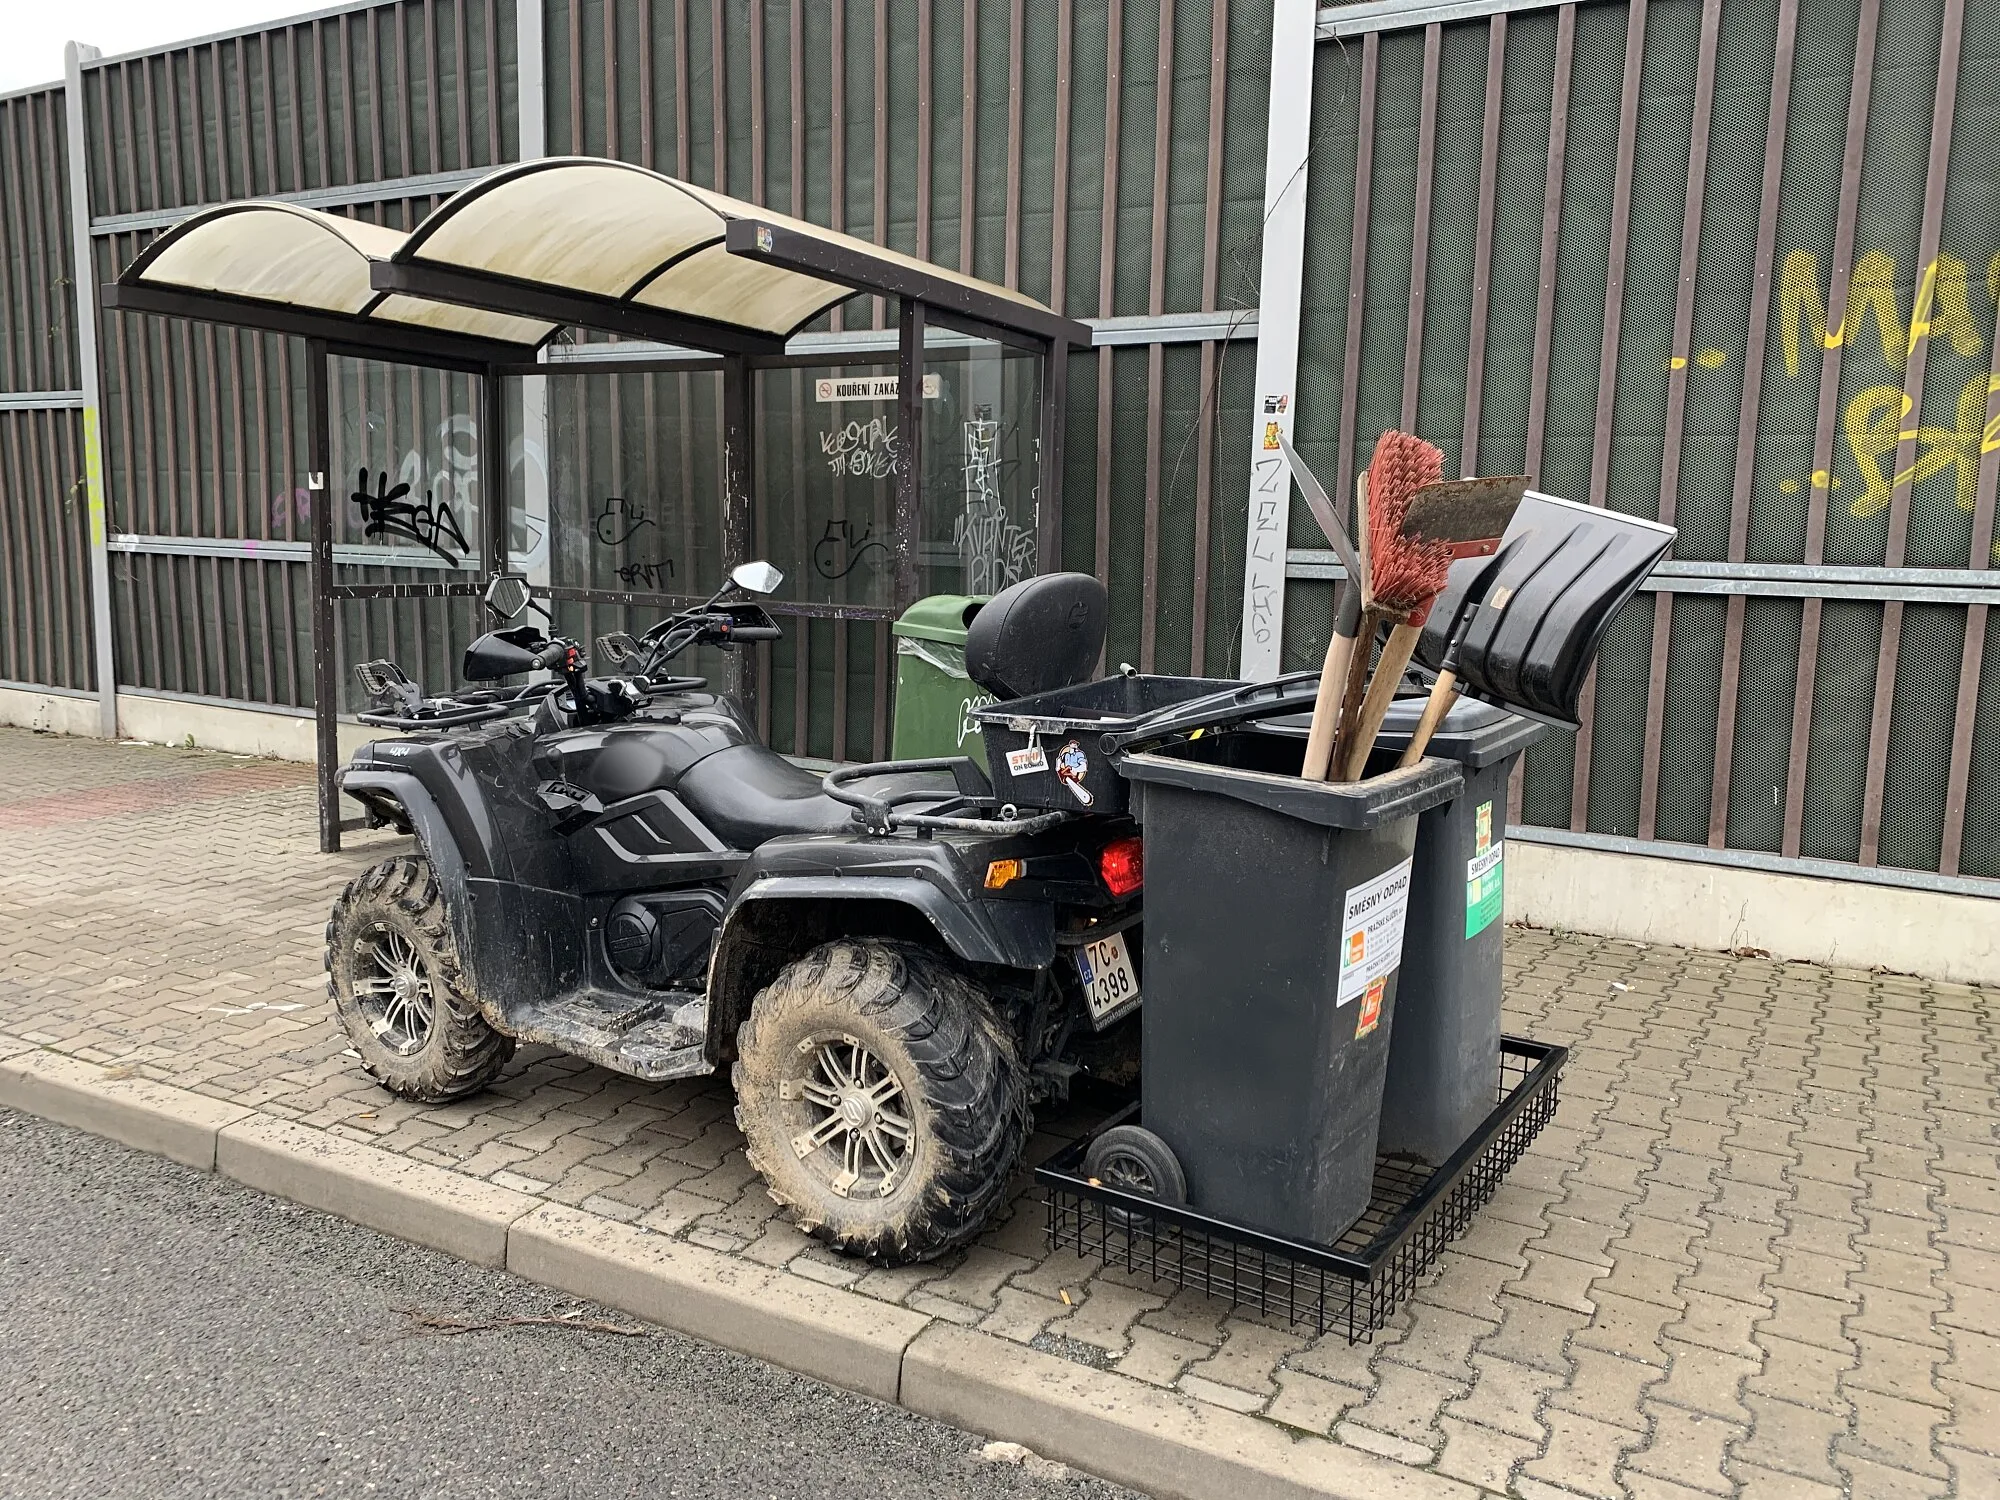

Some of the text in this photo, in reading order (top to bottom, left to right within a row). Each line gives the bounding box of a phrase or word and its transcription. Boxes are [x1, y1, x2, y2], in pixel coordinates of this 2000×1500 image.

[1779, 247, 2000, 378] MA
[836, 380, 899, 397] KOUŘENÍ ZAKÁZ
[1348, 875, 1408, 919] SMĚSNÝ ODPAD
[1083, 970, 1094, 980] CZ
[1088, 941, 1111, 974] 7C
[1090, 966, 1129, 1009] 4398
